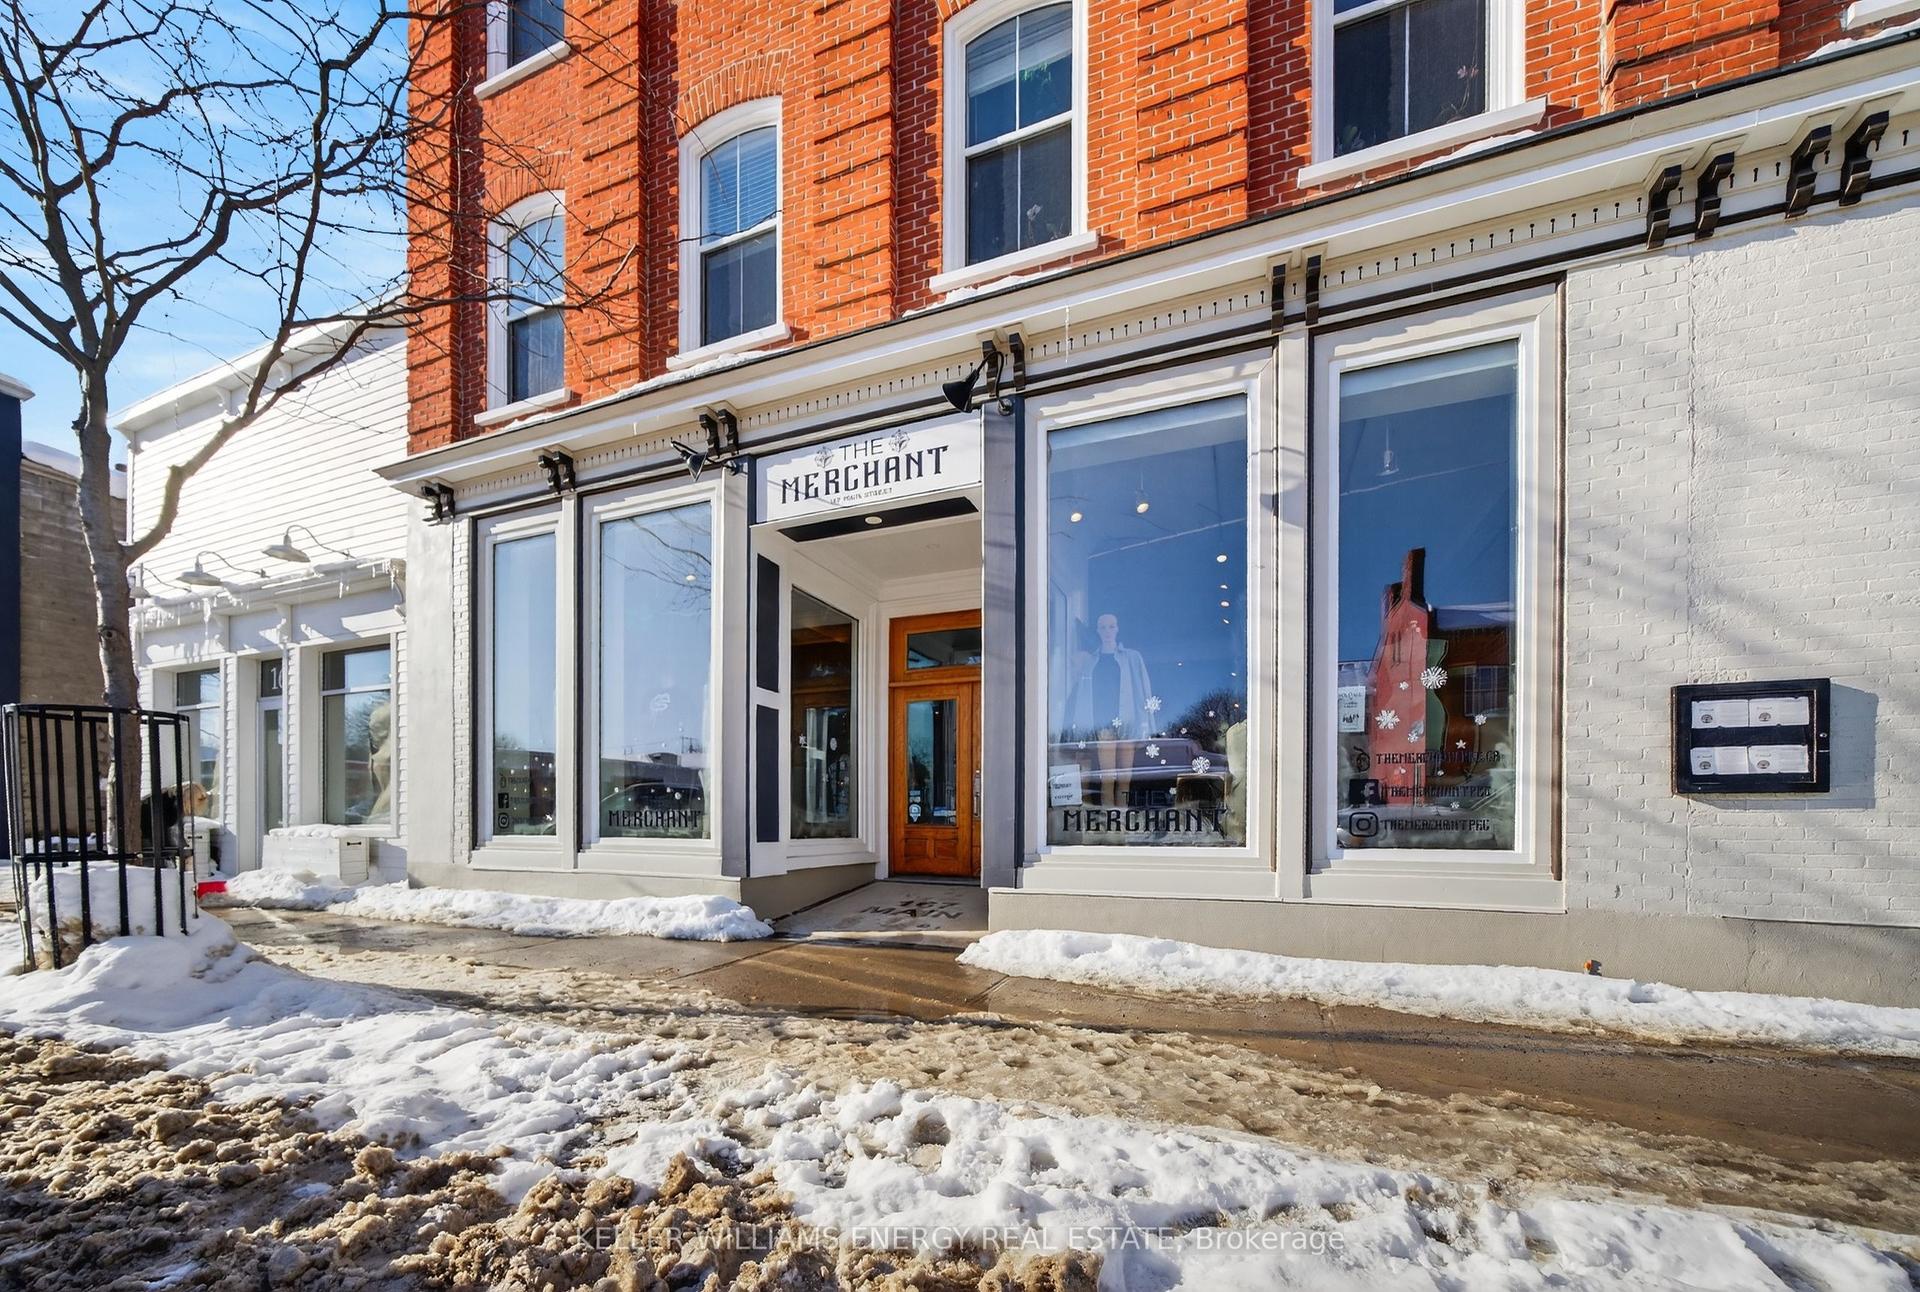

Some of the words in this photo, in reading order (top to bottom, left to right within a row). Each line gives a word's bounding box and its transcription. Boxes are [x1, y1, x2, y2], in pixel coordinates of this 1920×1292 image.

[839, 437, 884, 461] THE
[781, 445, 949, 504] MERCHANT
[608, 809, 701, 828] MERCHANT
[1062, 808, 1227, 833] MERCHANT
[860, 906, 963, 919] MAIN
